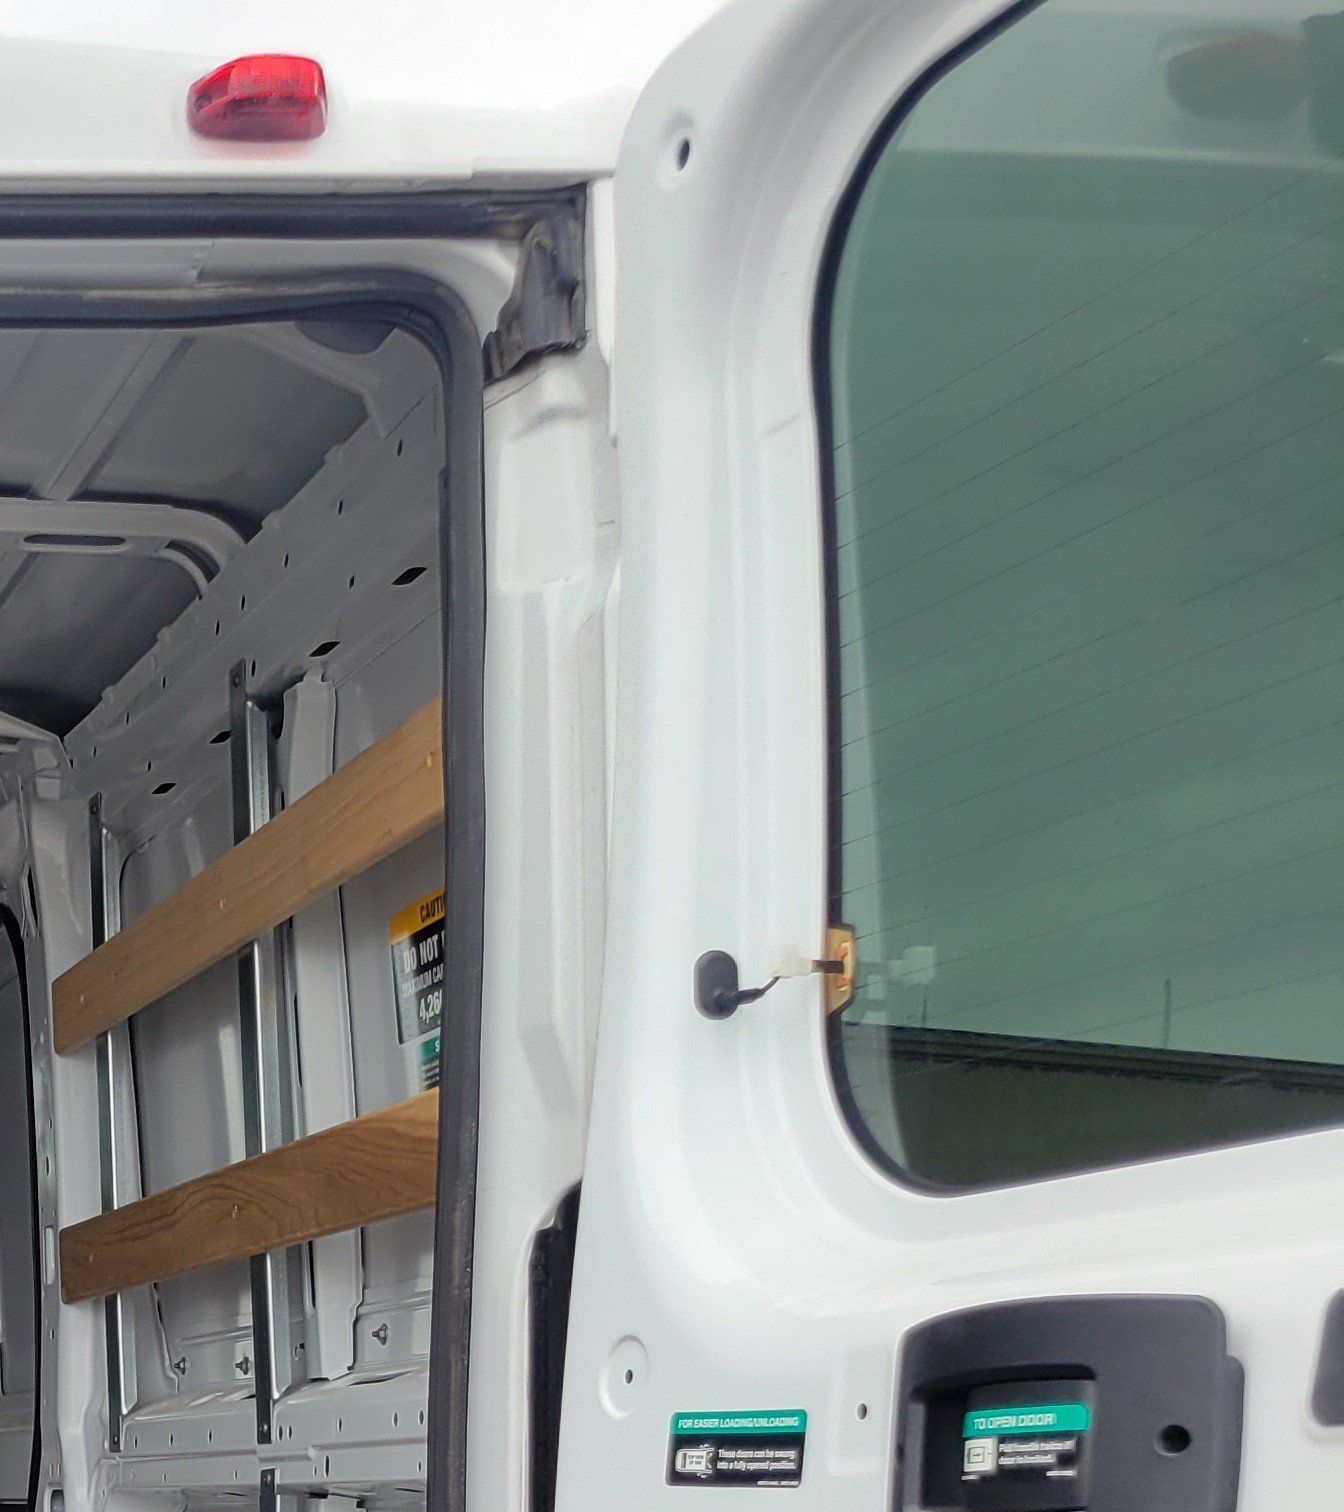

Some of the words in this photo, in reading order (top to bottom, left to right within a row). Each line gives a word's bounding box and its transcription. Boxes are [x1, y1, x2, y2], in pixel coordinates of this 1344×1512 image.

[419, 895, 444, 922] CAUTI
[403, 946, 417, 974] DO
[419, 935, 439, 966] NOT
[678, 1419, 694, 1429] FOR
[694, 1418, 719, 1428] EASIER
[720, 1416, 799, 1428] LOADING/UNLOADING
[973, 1418, 986, 1429] TO
[987, 1416, 1017, 1428] OPEN
[1018, 1413, 1056, 1427] DOOR
[753, 1450, 765, 1458] can
